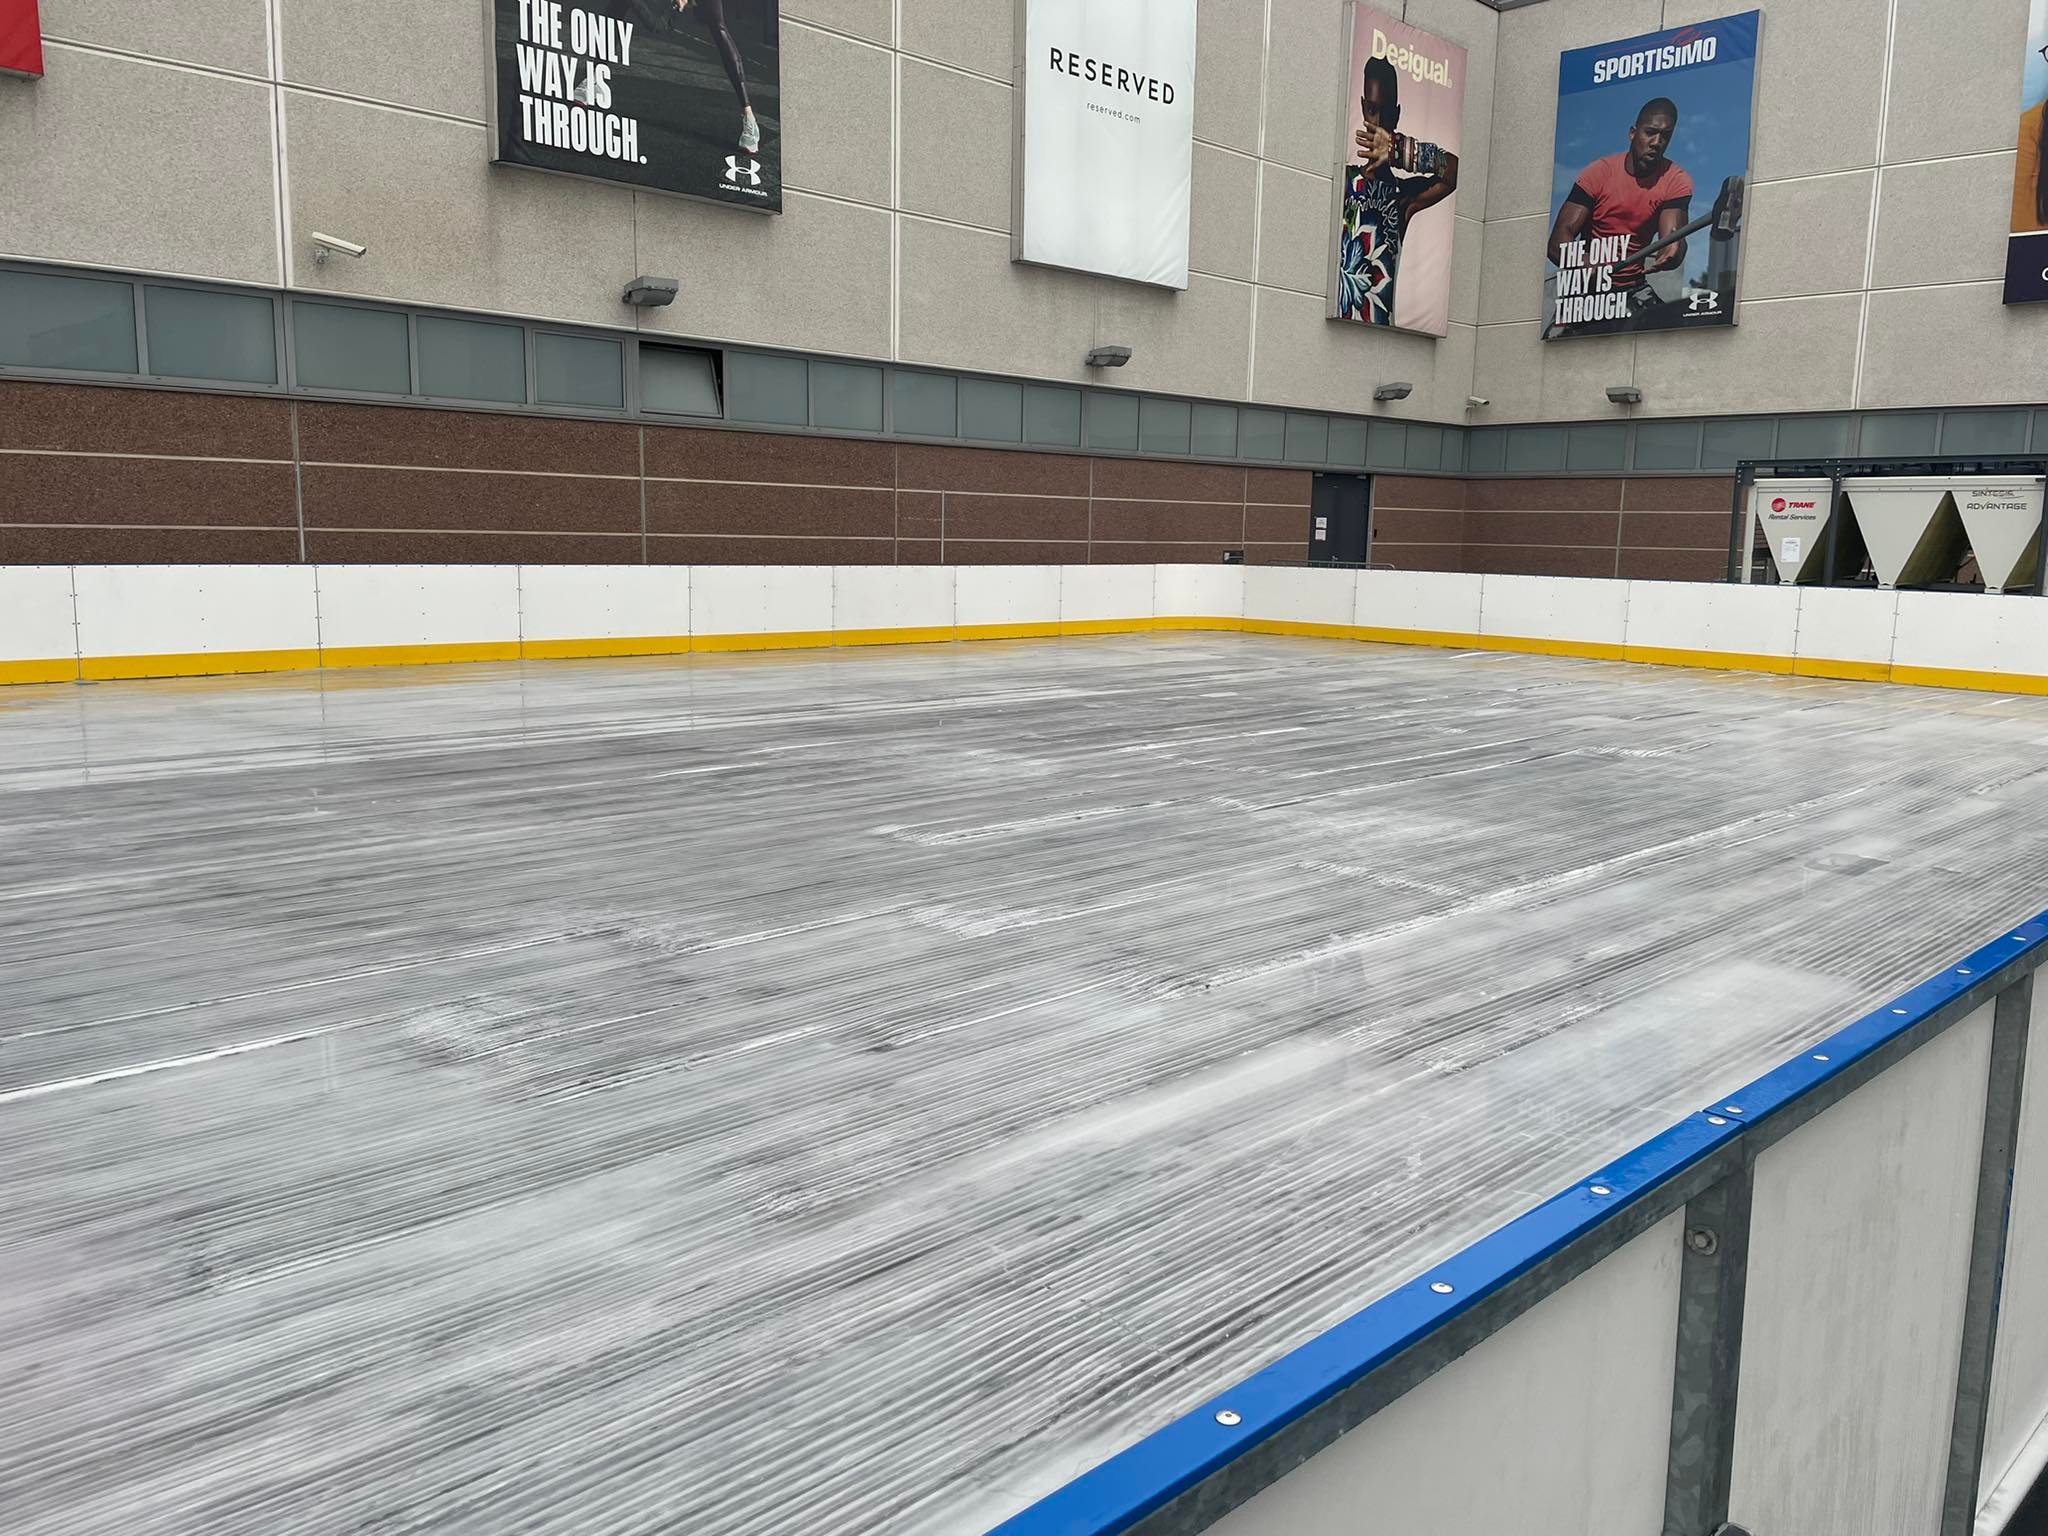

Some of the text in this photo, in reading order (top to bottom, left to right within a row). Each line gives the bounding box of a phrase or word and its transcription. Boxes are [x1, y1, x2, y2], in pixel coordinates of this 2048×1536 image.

[518, 0, 634, 66] THE ONLY
[516, 43, 612, 109] WAY IS
[1050, 47, 1175, 105] RESERVED
[1593, 36, 1717, 84] SPORTISIMO
[519, 94, 648, 165] THROUGH.
[1086, 101, 1141, 125] reserved.com
[718, 182, 768, 197] UNDER ARMOUR
[1558, 234, 1632, 269] THE ONLY
[1556, 264, 1614, 297] WAY IS
[1554, 291, 1632, 325] THROUGH.
[1788, 501, 1816, 509] TRANE
[1966, 500, 2028, 511] ADVANTAGE
